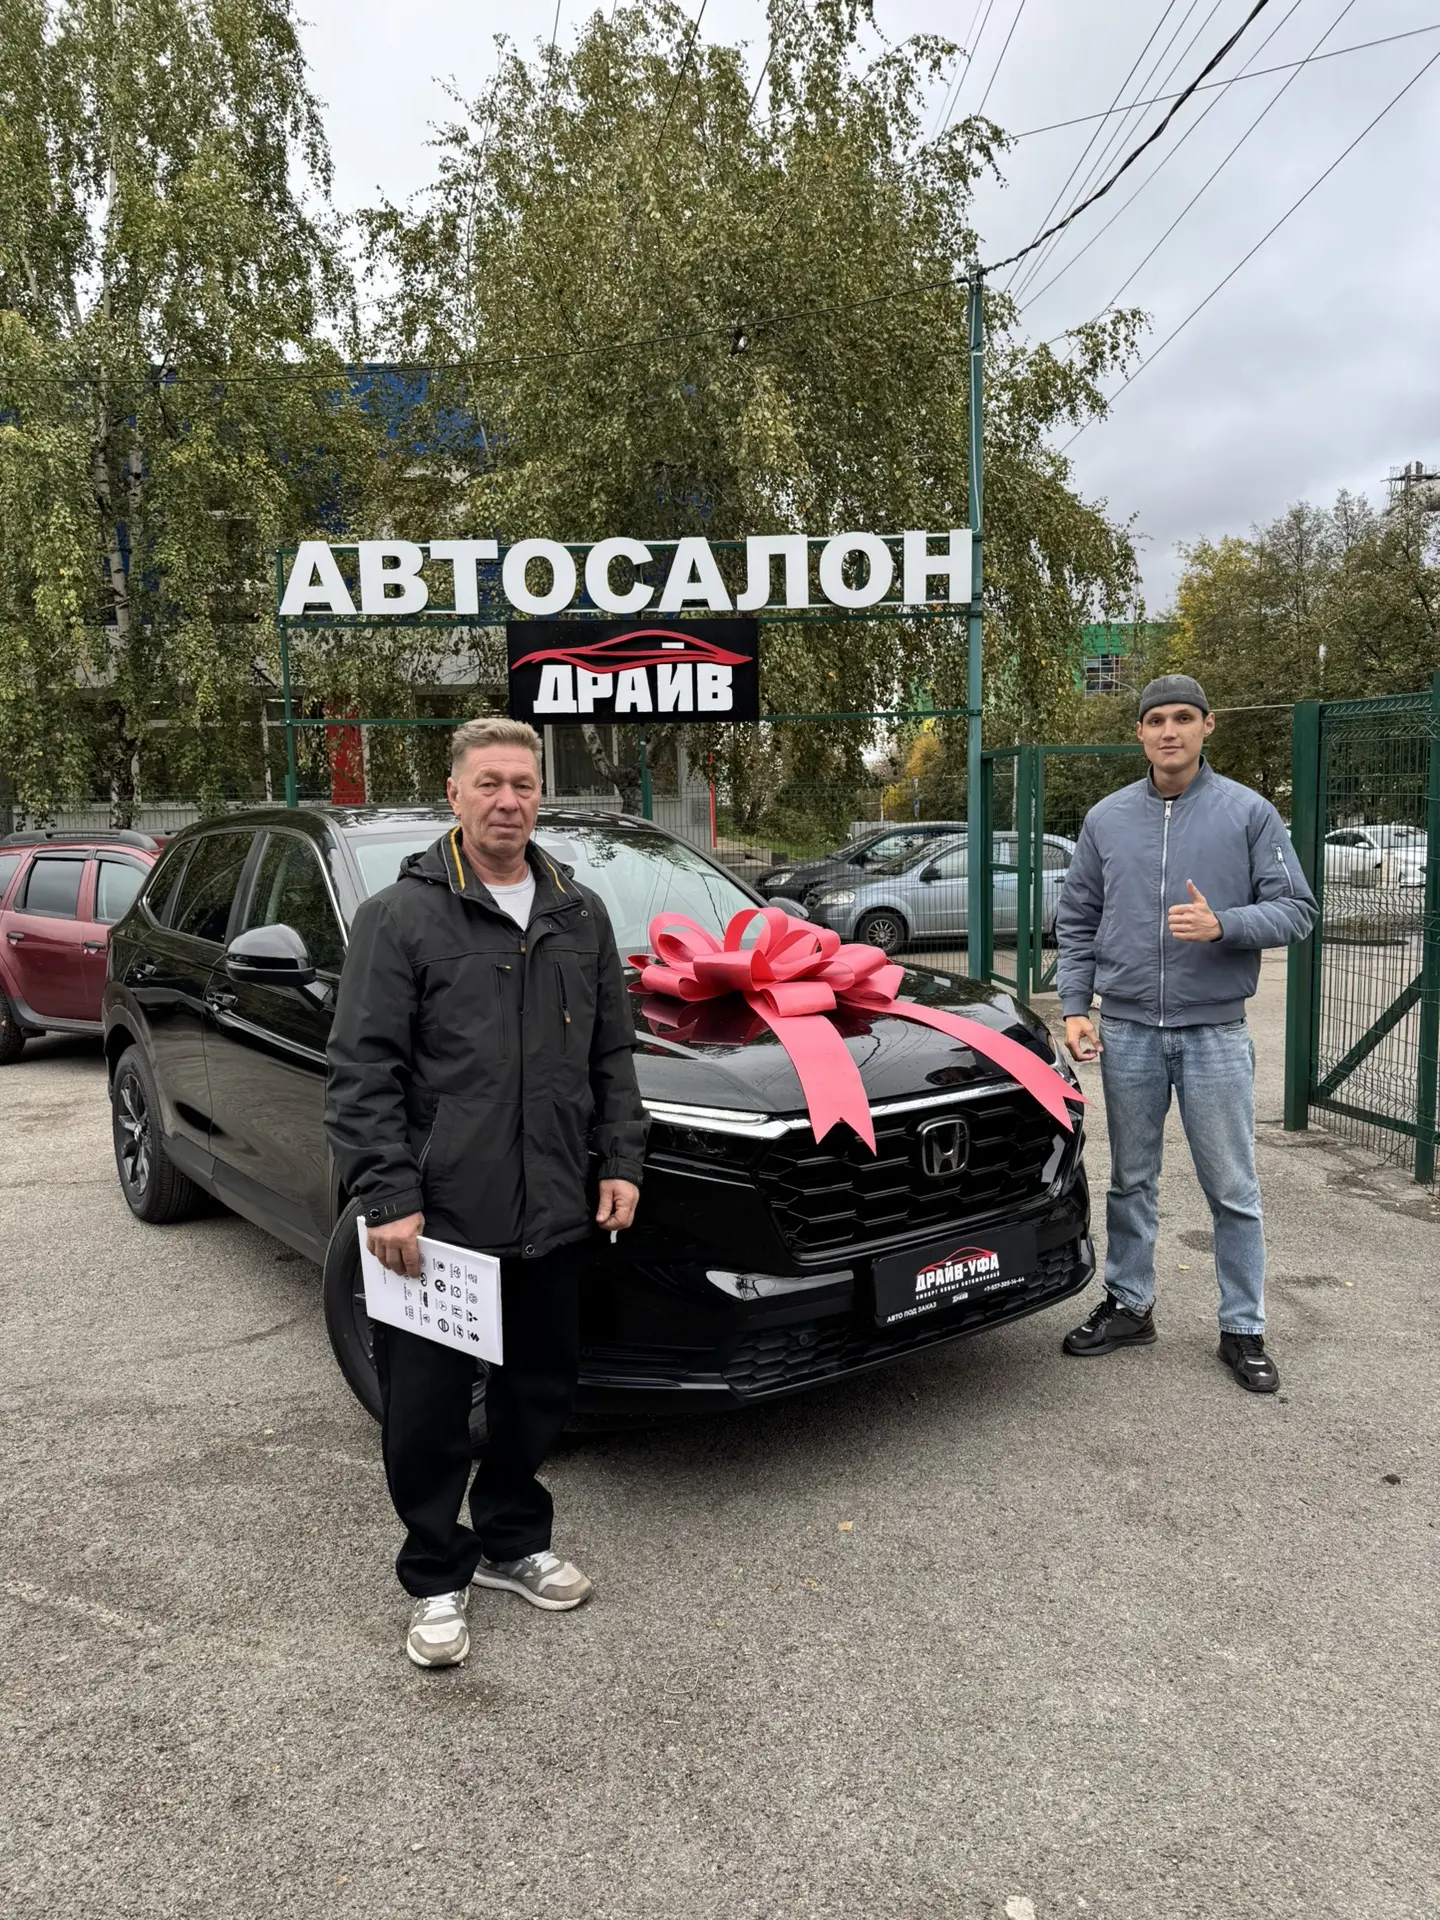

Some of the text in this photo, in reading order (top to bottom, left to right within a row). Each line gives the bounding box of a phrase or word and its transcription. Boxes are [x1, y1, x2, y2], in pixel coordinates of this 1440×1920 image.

[279, 529, 973, 615] АВТОСАЛОН
[533, 642, 733, 713] ДРАЙВ
[915, 1253, 1000, 1292] ДРАЙВ-УФА
[886, 1301, 937, 1323] АВТО ПОД ЗАКАЗ
